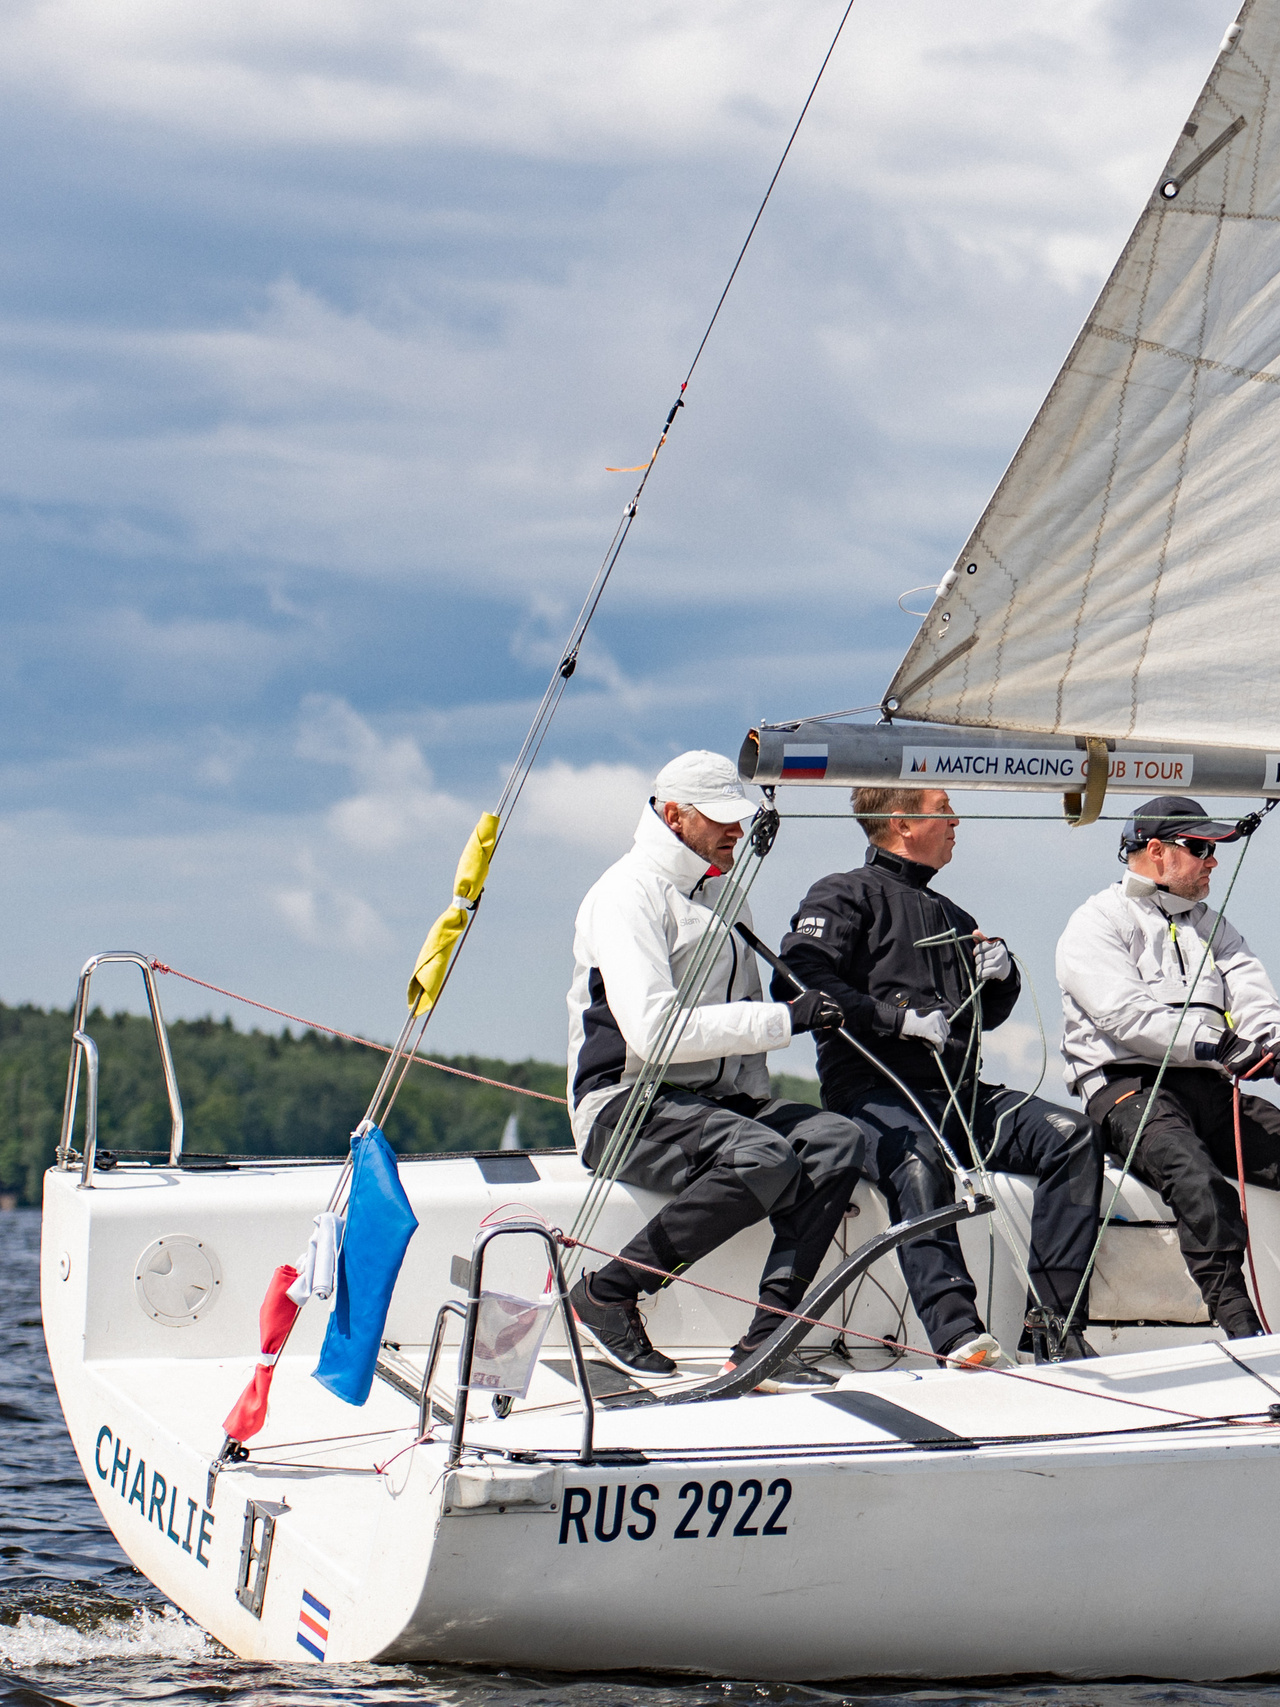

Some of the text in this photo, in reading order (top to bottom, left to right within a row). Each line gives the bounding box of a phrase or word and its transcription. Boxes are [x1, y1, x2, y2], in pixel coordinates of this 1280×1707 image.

[935, 755, 1184, 780] MATCH RACING CUB TOUR
[95, 1425, 215, 1569] CHARLIE
[558, 1478, 793, 1544] RUS 2922
